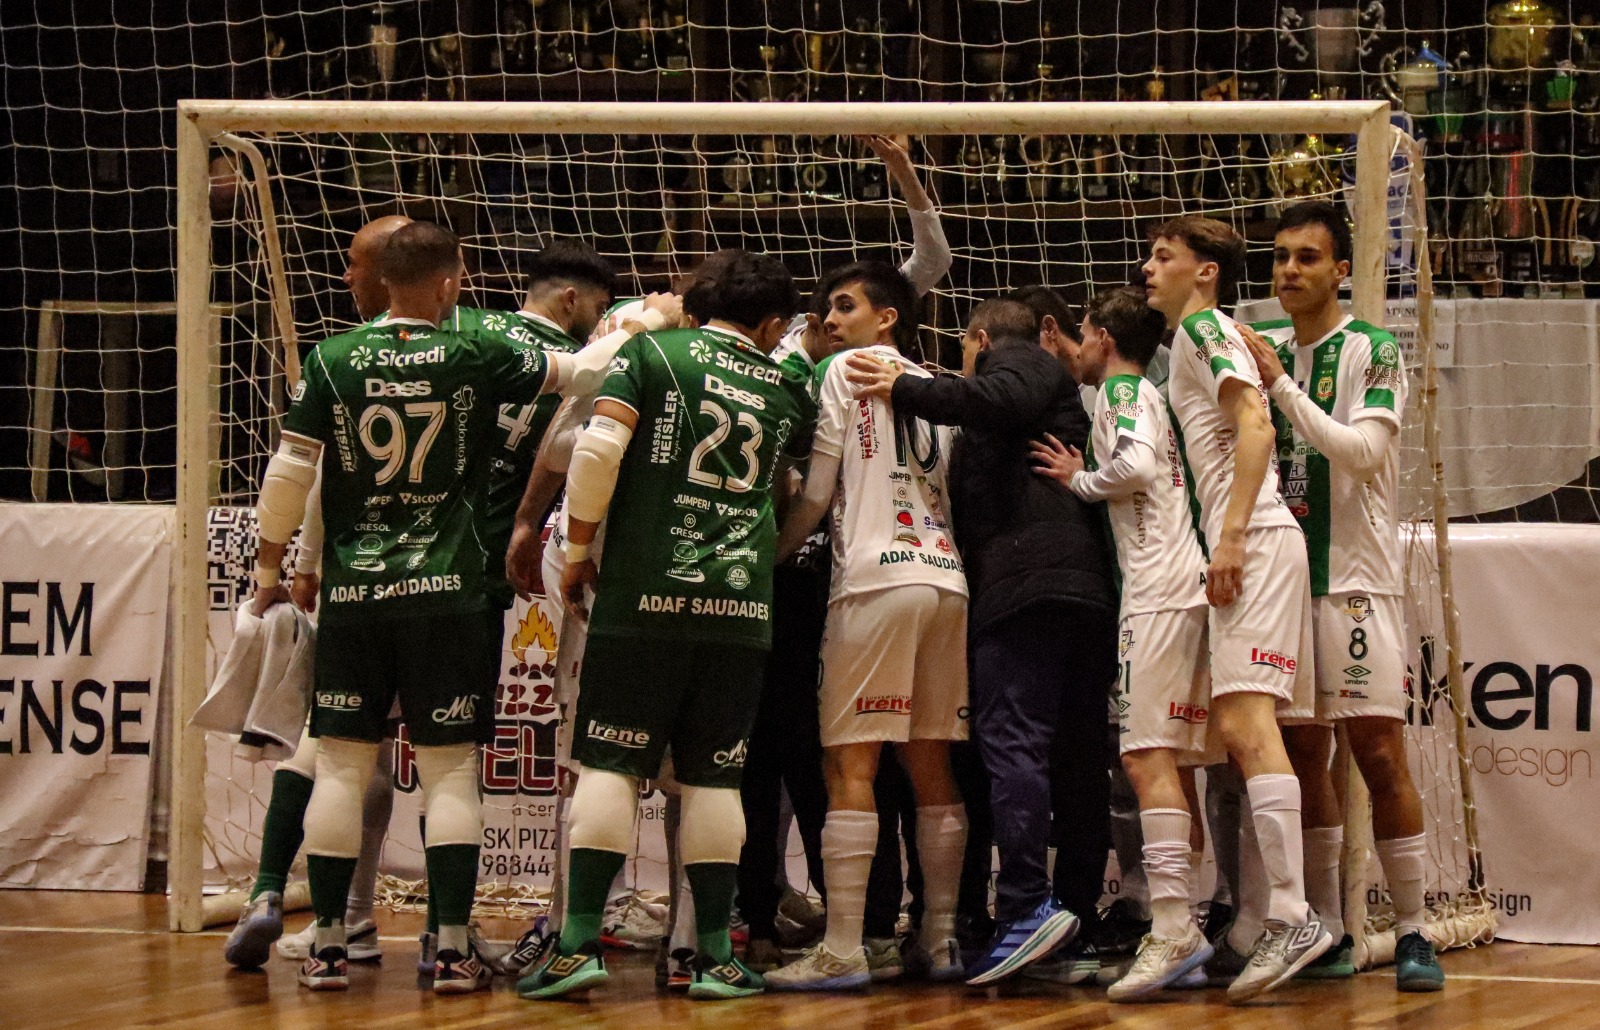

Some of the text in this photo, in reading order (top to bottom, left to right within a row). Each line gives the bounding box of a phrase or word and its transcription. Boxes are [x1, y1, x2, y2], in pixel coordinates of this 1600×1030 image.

[376, 345, 446, 367] Sicredi
[715, 351, 783, 386] Sicredi
[365, 378, 432, 397] Dass
[704, 374, 766, 410] Dass
[651, 417, 662, 463] MASSAS
[659, 390, 678, 463] HEISLER
[860, 396, 873, 459] HEISLER
[358, 401, 447, 486] 97
[687, 400, 763, 493] 23
[673, 493, 711, 511] JUMPER!
[354, 523, 391, 532] CRESOL
[670, 526, 705, 541] CRESOL
[880, 550, 916, 566] ADAF
[329, 574, 462, 603] ADAF SAUDADES
[2, 579, 95, 657] EM
[638, 594, 769, 620] ADAF SAUDADES
[1251, 648, 1297, 671] Irene
[1348, 627, 1369, 661] 8
[1405, 636, 1593, 732] ken
[587, 719, 651, 745] Irene
[1471, 738, 1592, 787] design
[483, 827, 511, 850] SK
